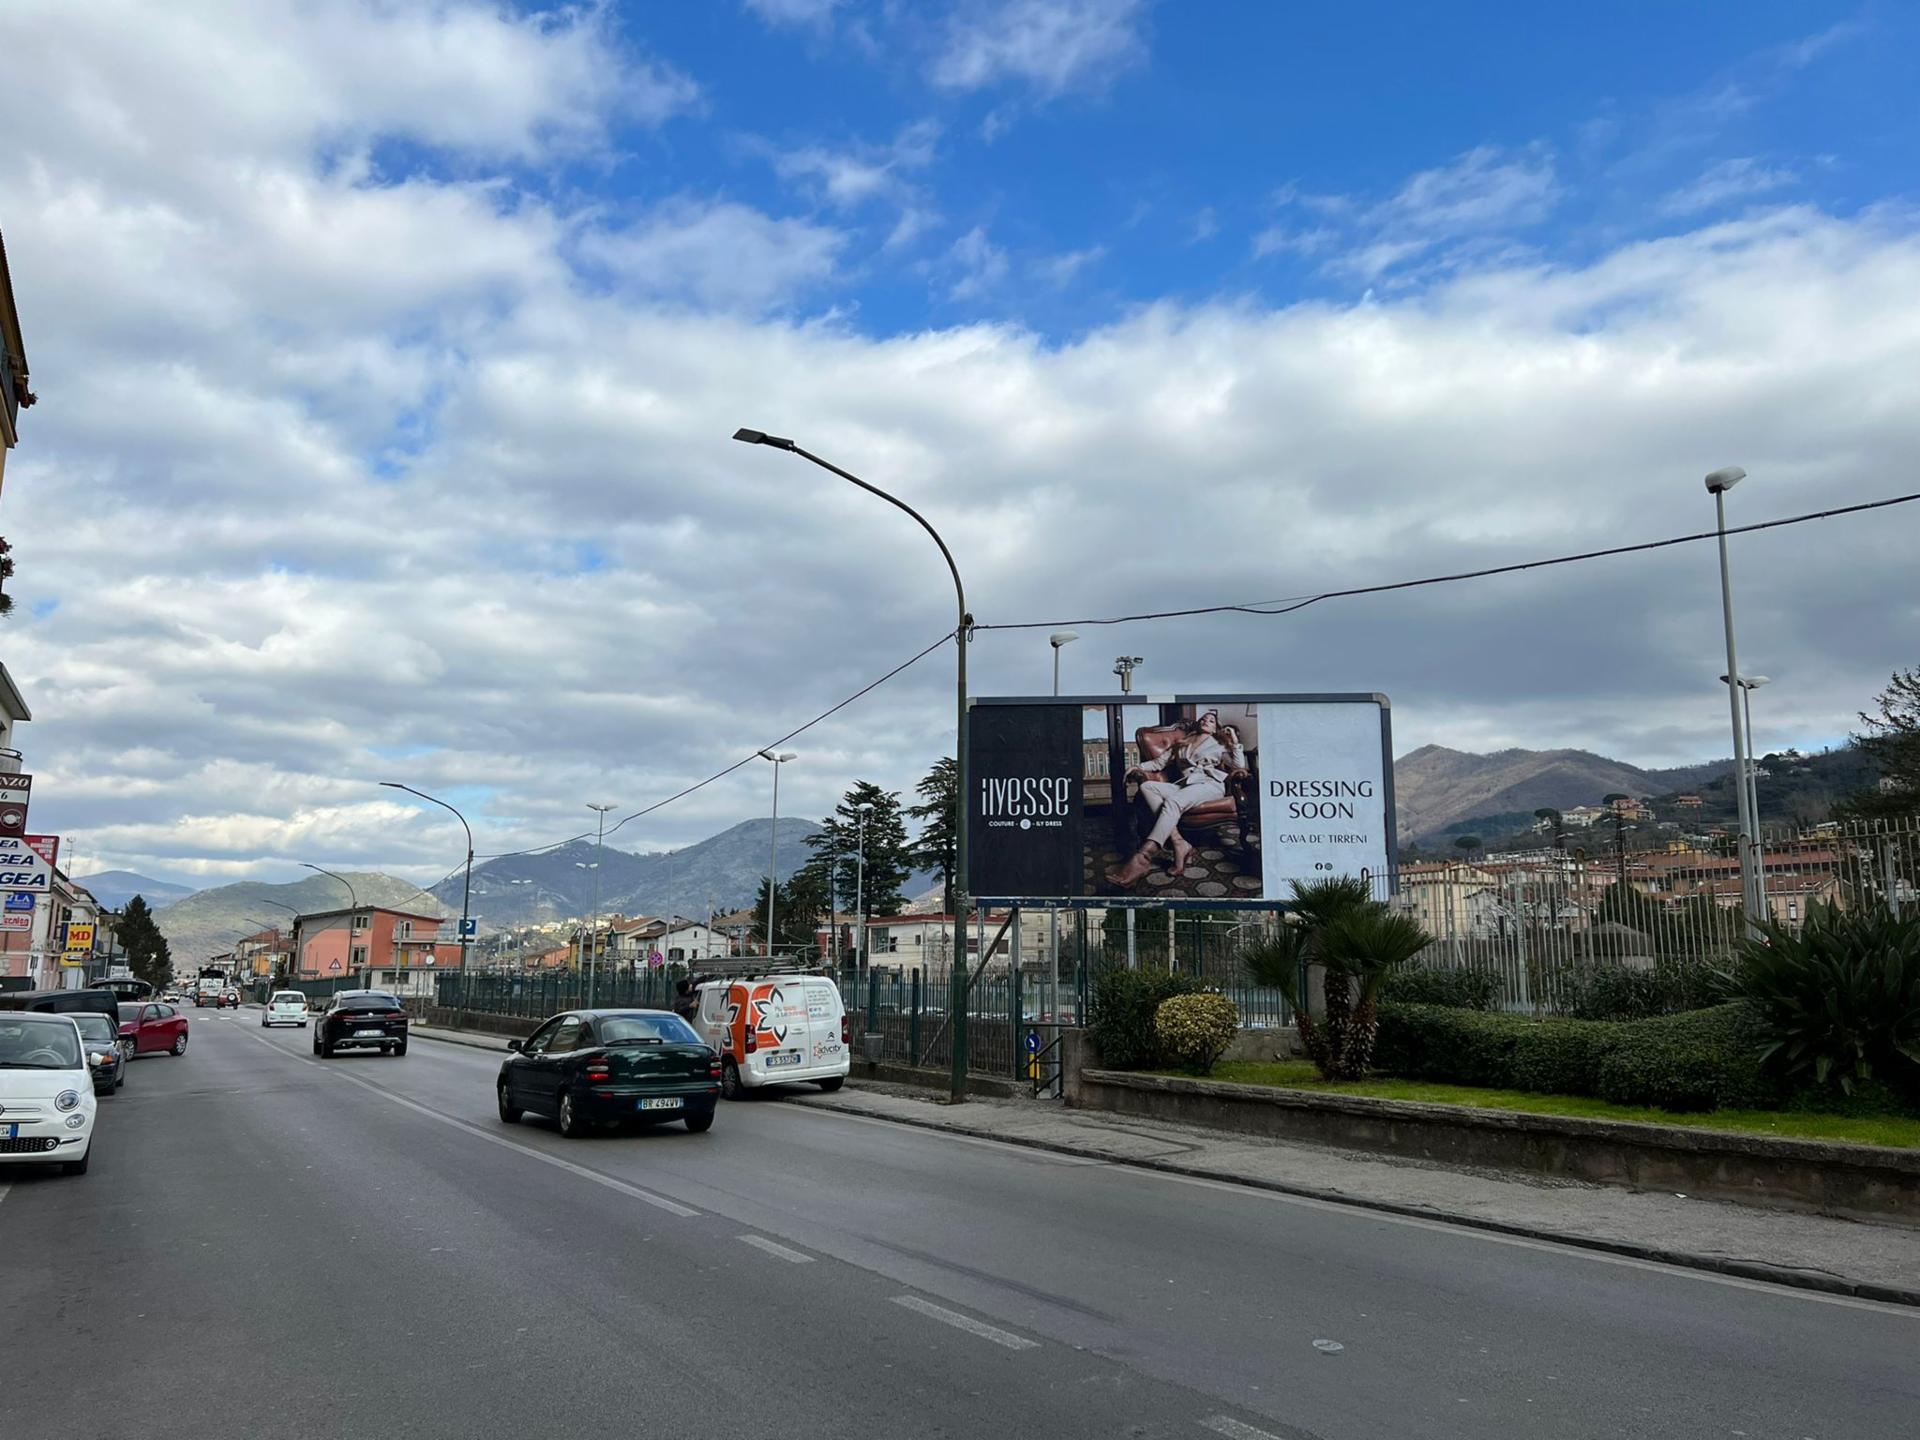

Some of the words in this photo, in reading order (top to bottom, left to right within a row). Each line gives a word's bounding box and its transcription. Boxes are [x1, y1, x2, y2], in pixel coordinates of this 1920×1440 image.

[1270, 780, 1373, 798] DRESSING
[1288, 801, 1354, 819] SOON
[1280, 834, 1307, 844] CAVA
[1309, 834, 1325, 844] DE'
[1328, 834, 1368, 844] TIRRENI
[0, 871, 46, 886] GEA
[69, 930, 92, 942] MD
